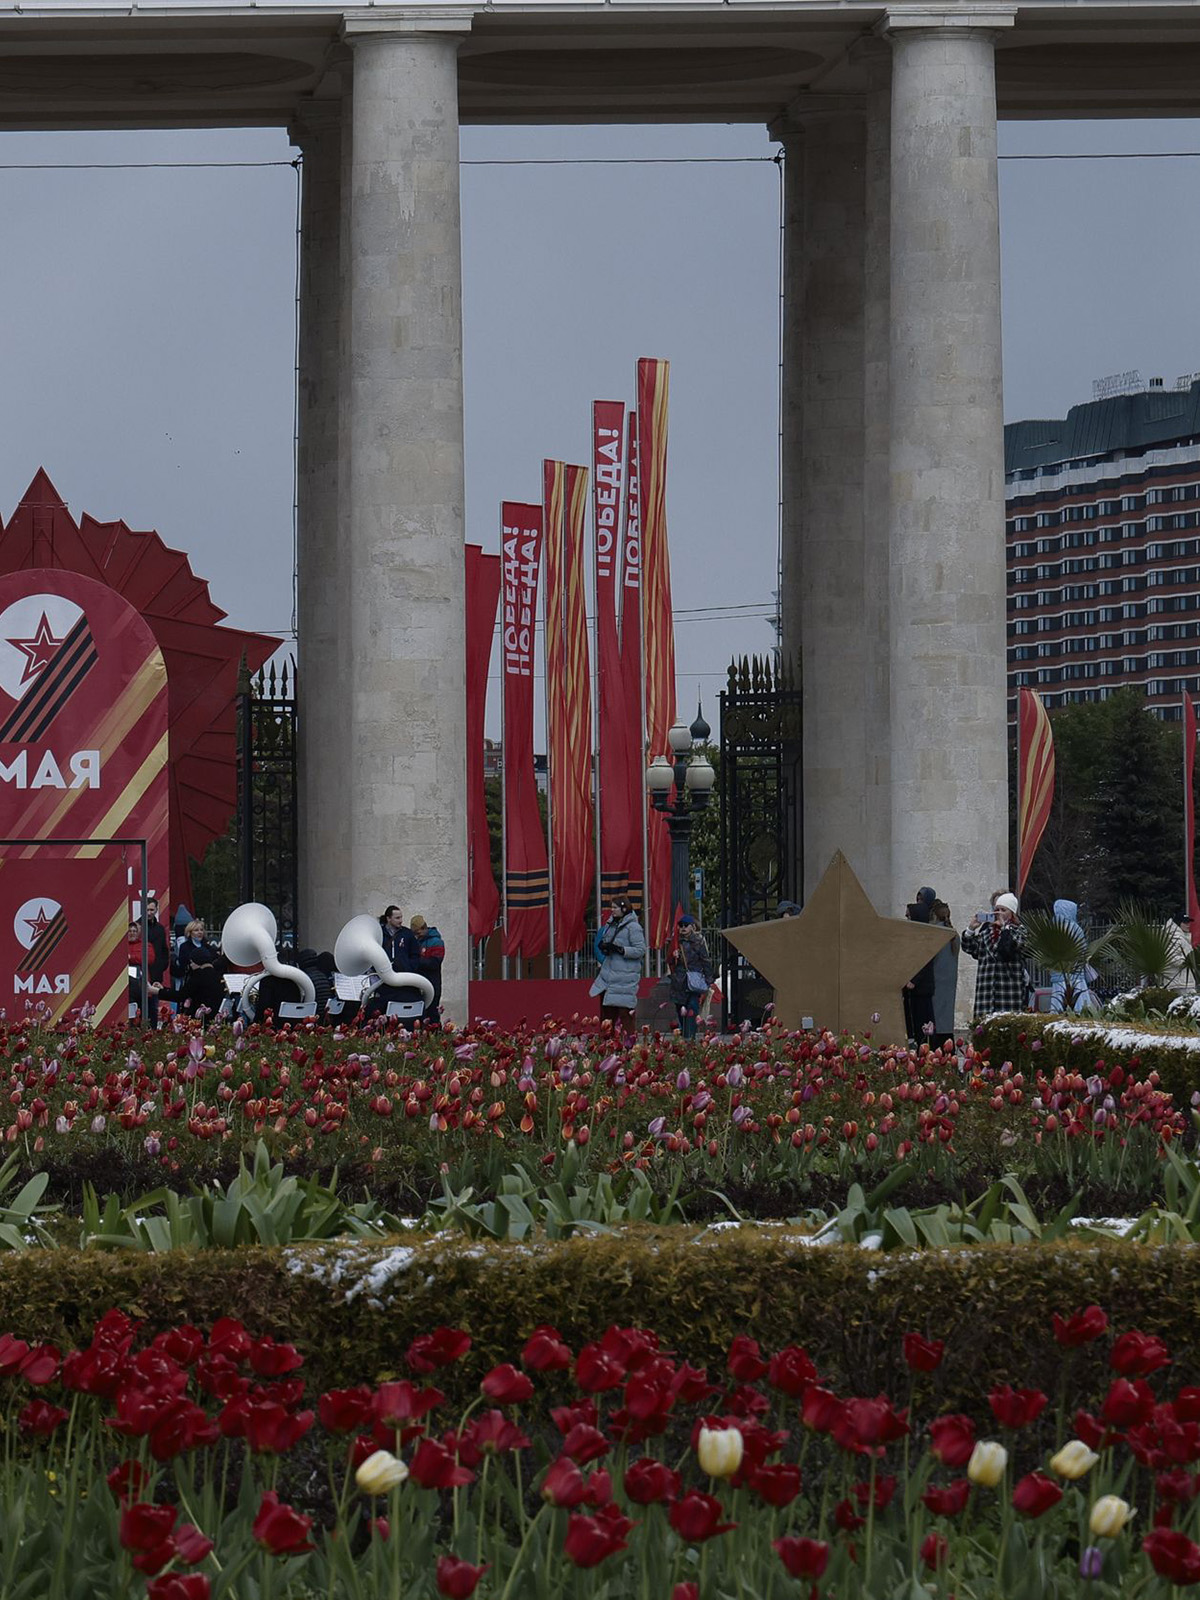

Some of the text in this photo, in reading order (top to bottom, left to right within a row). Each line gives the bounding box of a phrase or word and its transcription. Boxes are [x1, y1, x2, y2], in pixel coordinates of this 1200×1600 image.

[597, 428, 621, 576] ПОБЕДА!
[503, 526, 519, 675] ПОБЕДА!
[519, 529, 538, 676] ПОБЕДА!
[13, 973, 70, 994] МАЯ
